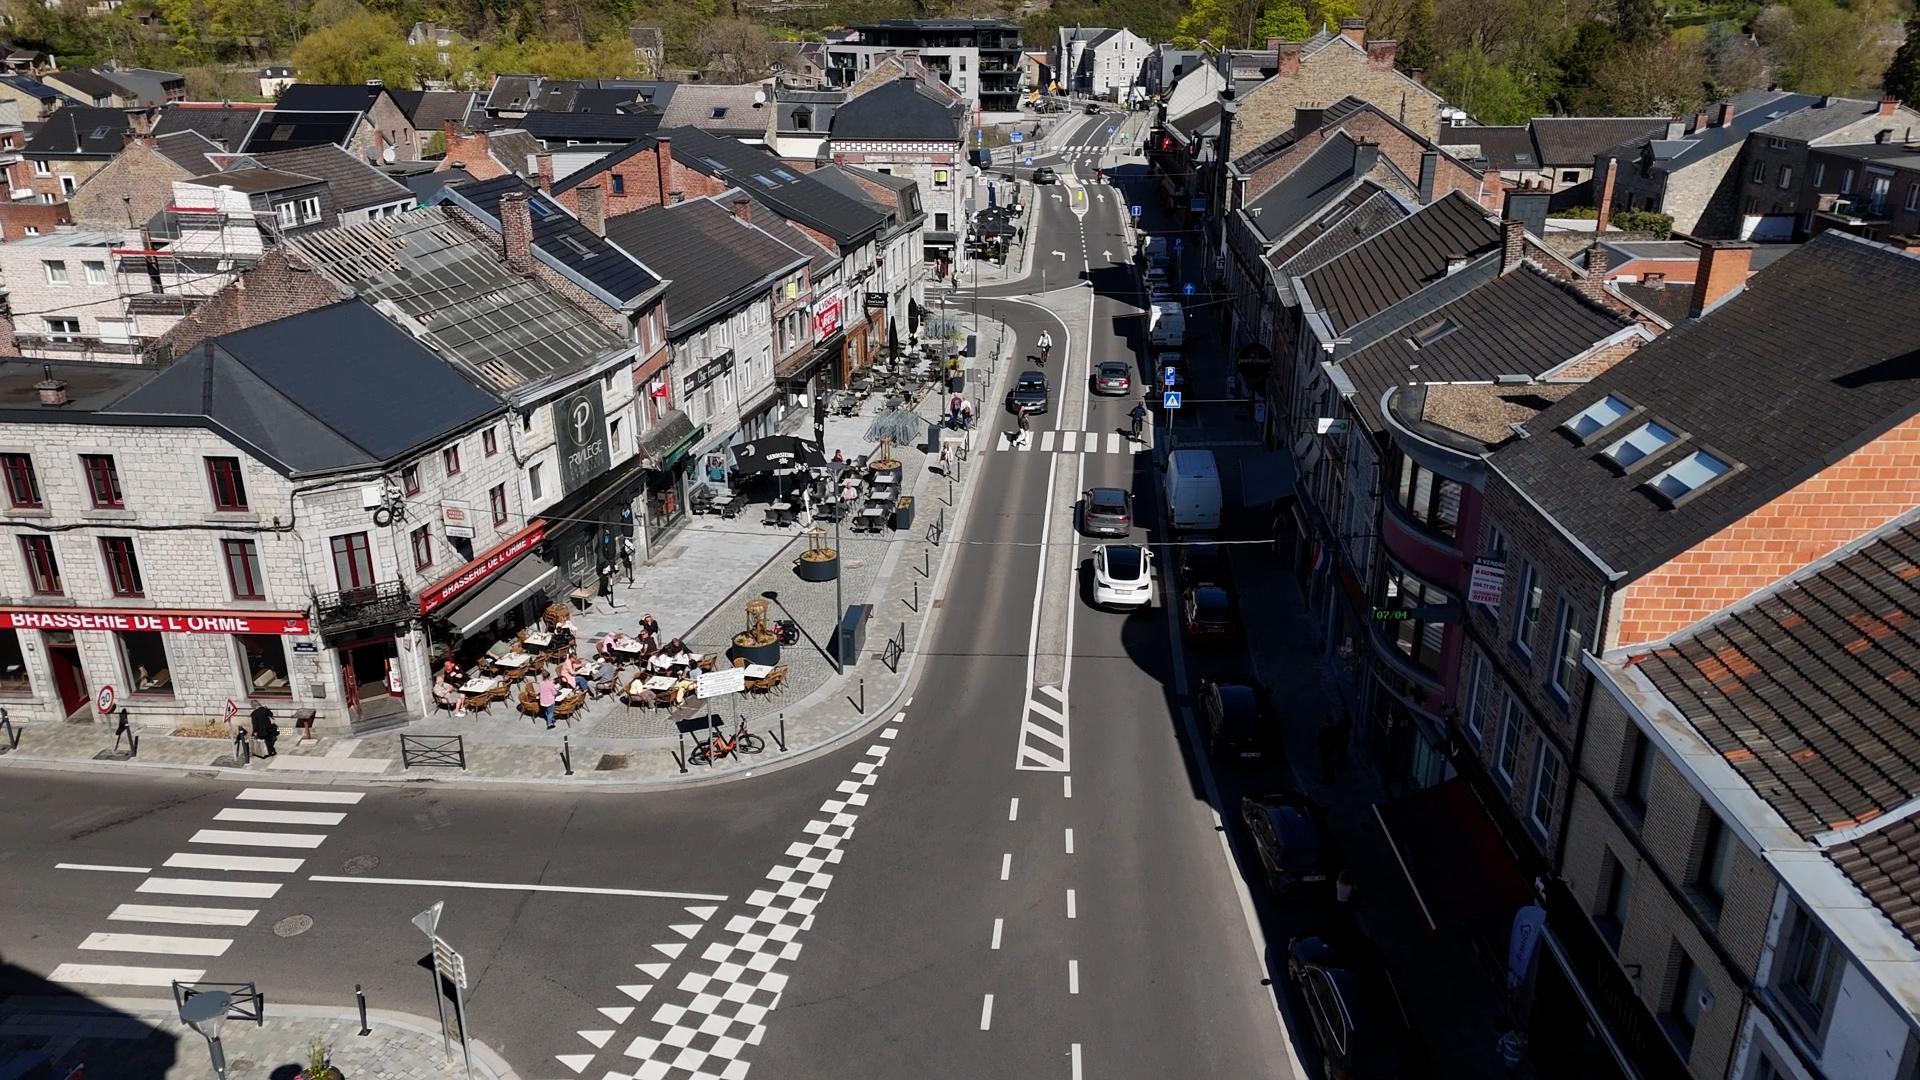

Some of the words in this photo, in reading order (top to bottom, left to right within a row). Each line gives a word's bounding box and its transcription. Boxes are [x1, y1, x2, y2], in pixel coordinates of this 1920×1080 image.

[1167, 368, 1174, 376] P
[442, 566, 487, 598] BRASSERIE
[10, 613, 129, 629] BRASSERIE
[134, 616, 163, 630] DE
[1376, 611, 1407, 620] 07/04
[101, 692, 110, 707] 30
